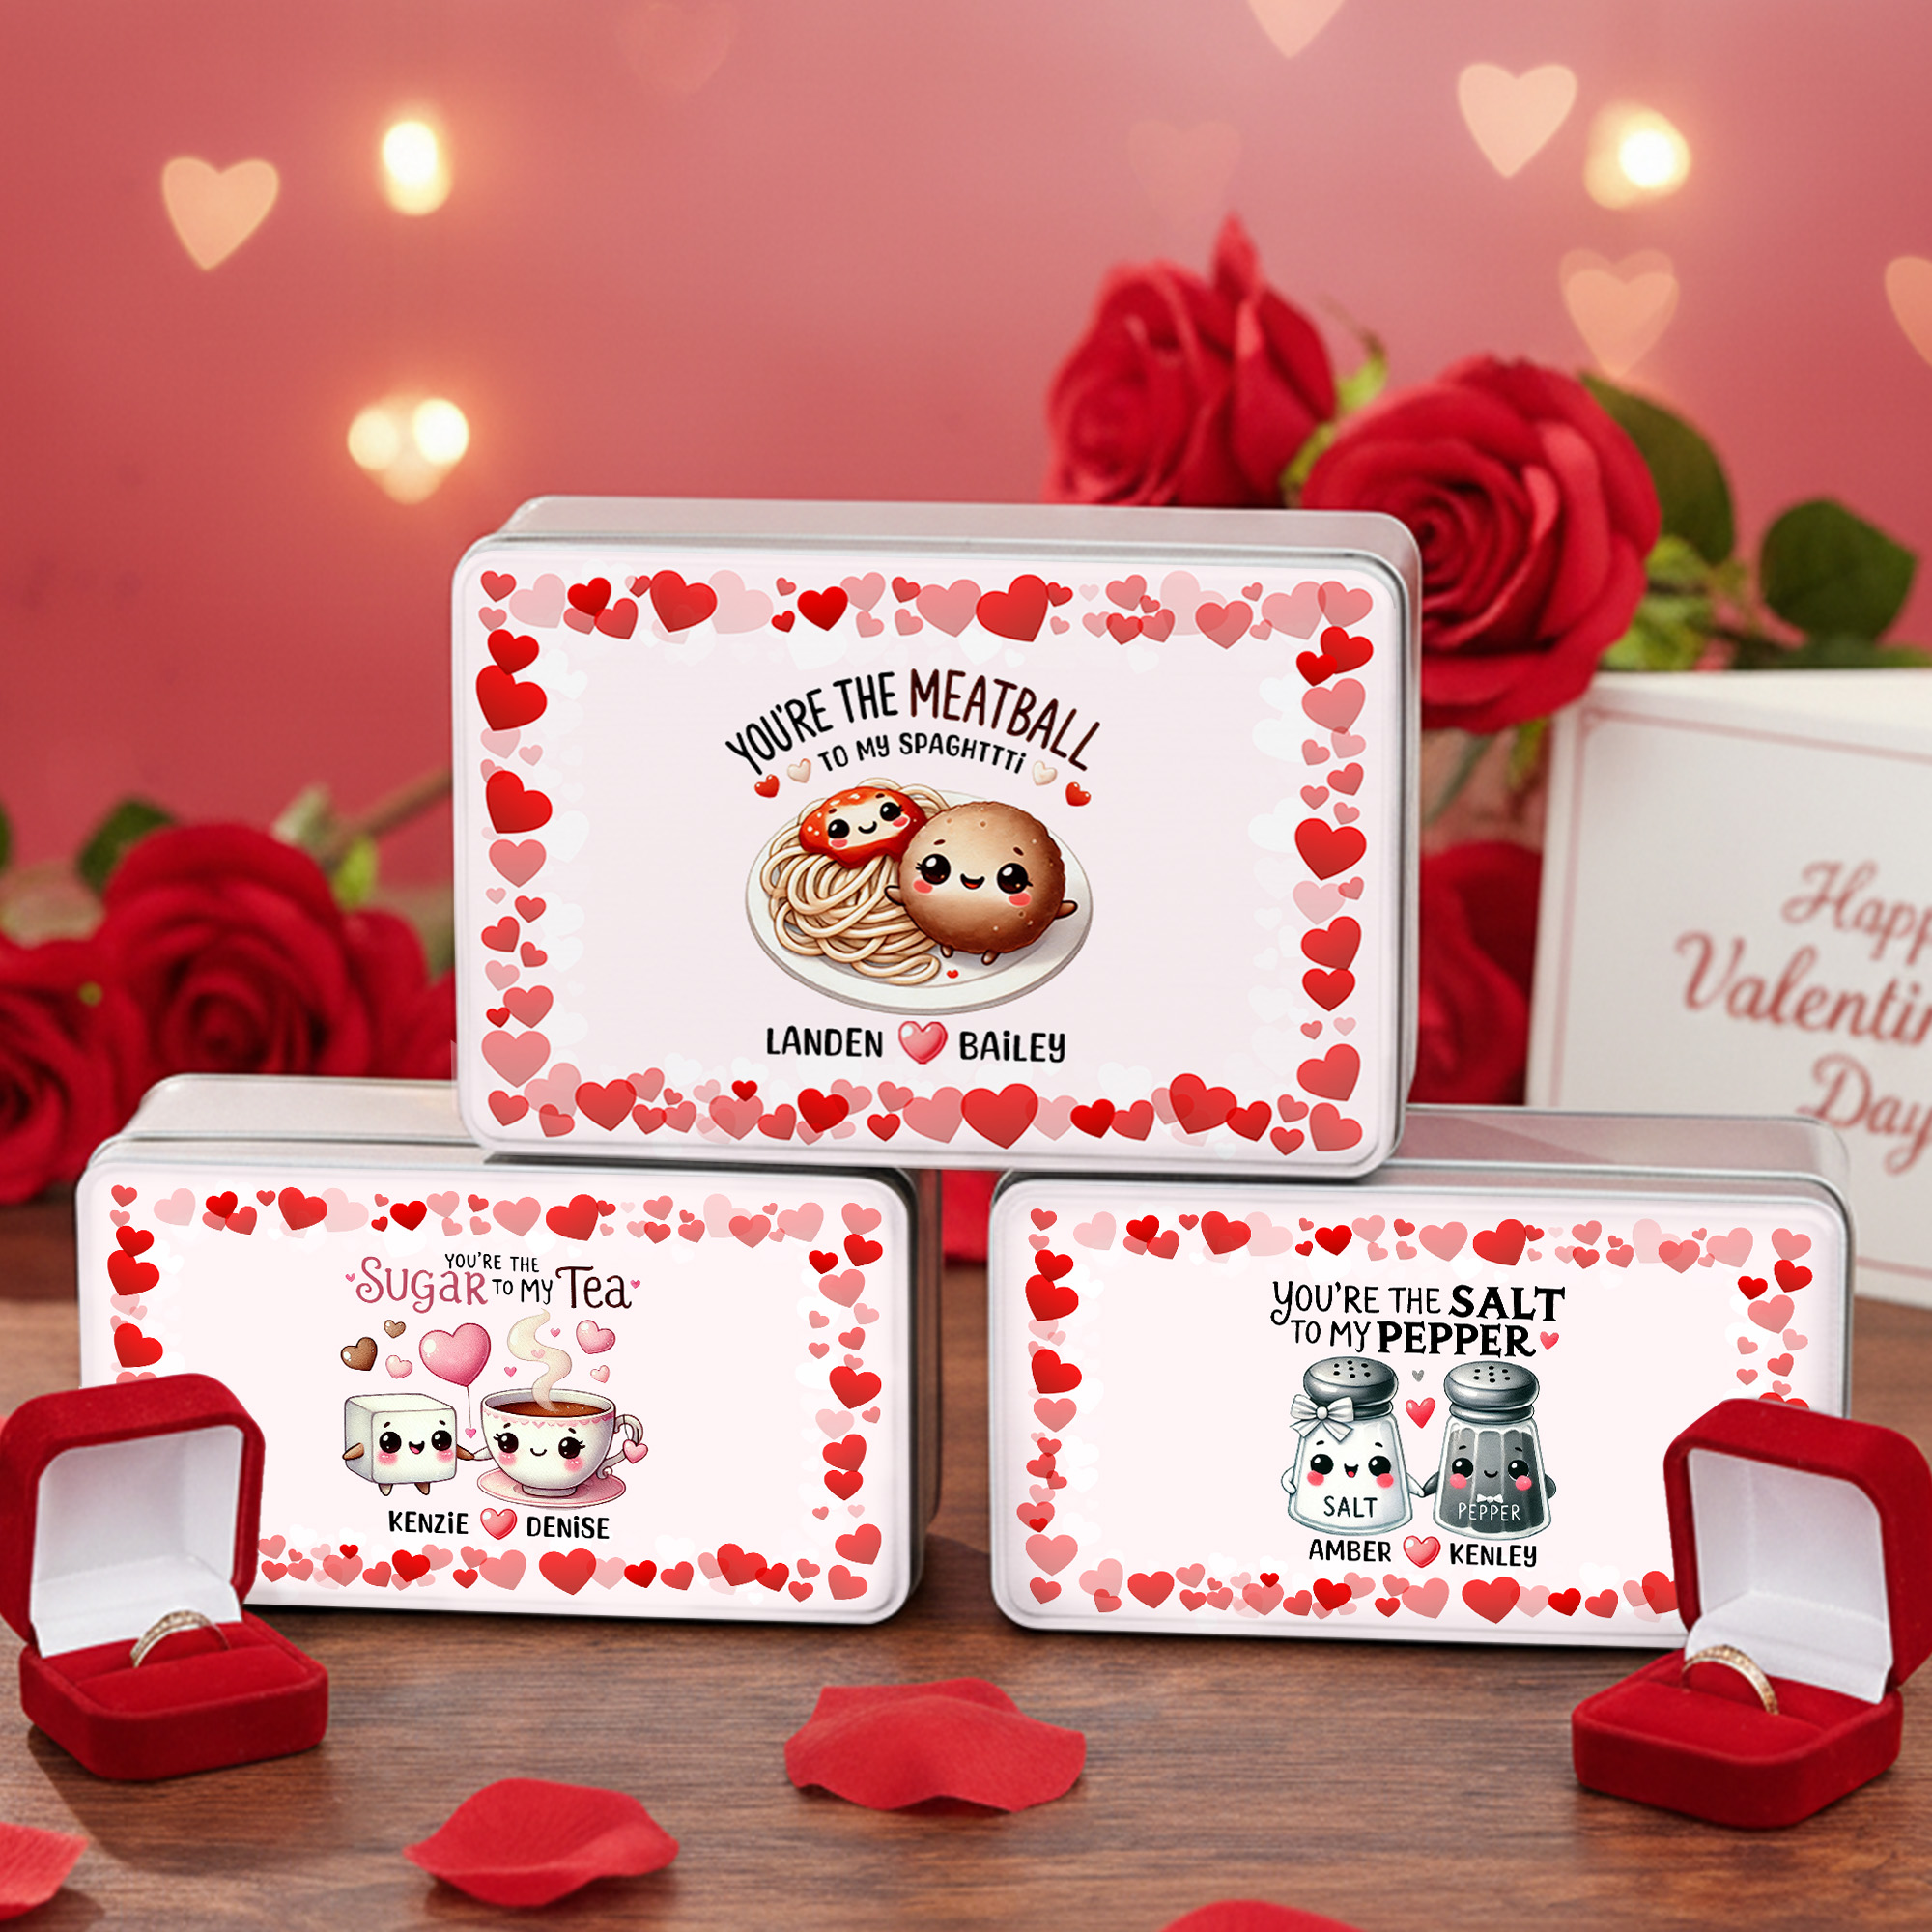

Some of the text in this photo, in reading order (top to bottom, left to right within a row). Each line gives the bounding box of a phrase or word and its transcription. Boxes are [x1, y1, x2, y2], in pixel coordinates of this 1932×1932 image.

[725, 668, 1100, 775] YOU'RE THE MEATBALL
[817, 745, 848, 772] TO
[856, 735, 889, 761] MY
[766, 1024, 883, 1058] LANDEN
[1795, 1052, 1932, 1176] Day
[445, 1251, 540, 1272] YOU'RE THE
[492, 1279, 514, 1294] TO
[521, 1279, 553, 1305] MY
[555, 1266, 632, 1309] Tea
[1270, 1281, 1566, 1325] YOU'RE THE SALT
[1291, 1320, 1536, 1358] TO MY PEPPER
[1323, 1496, 1378, 1518] SALT
[1458, 1502, 1521, 1521] PEPPER
[1309, 1539, 1537, 1567] AMBER KENLEY
